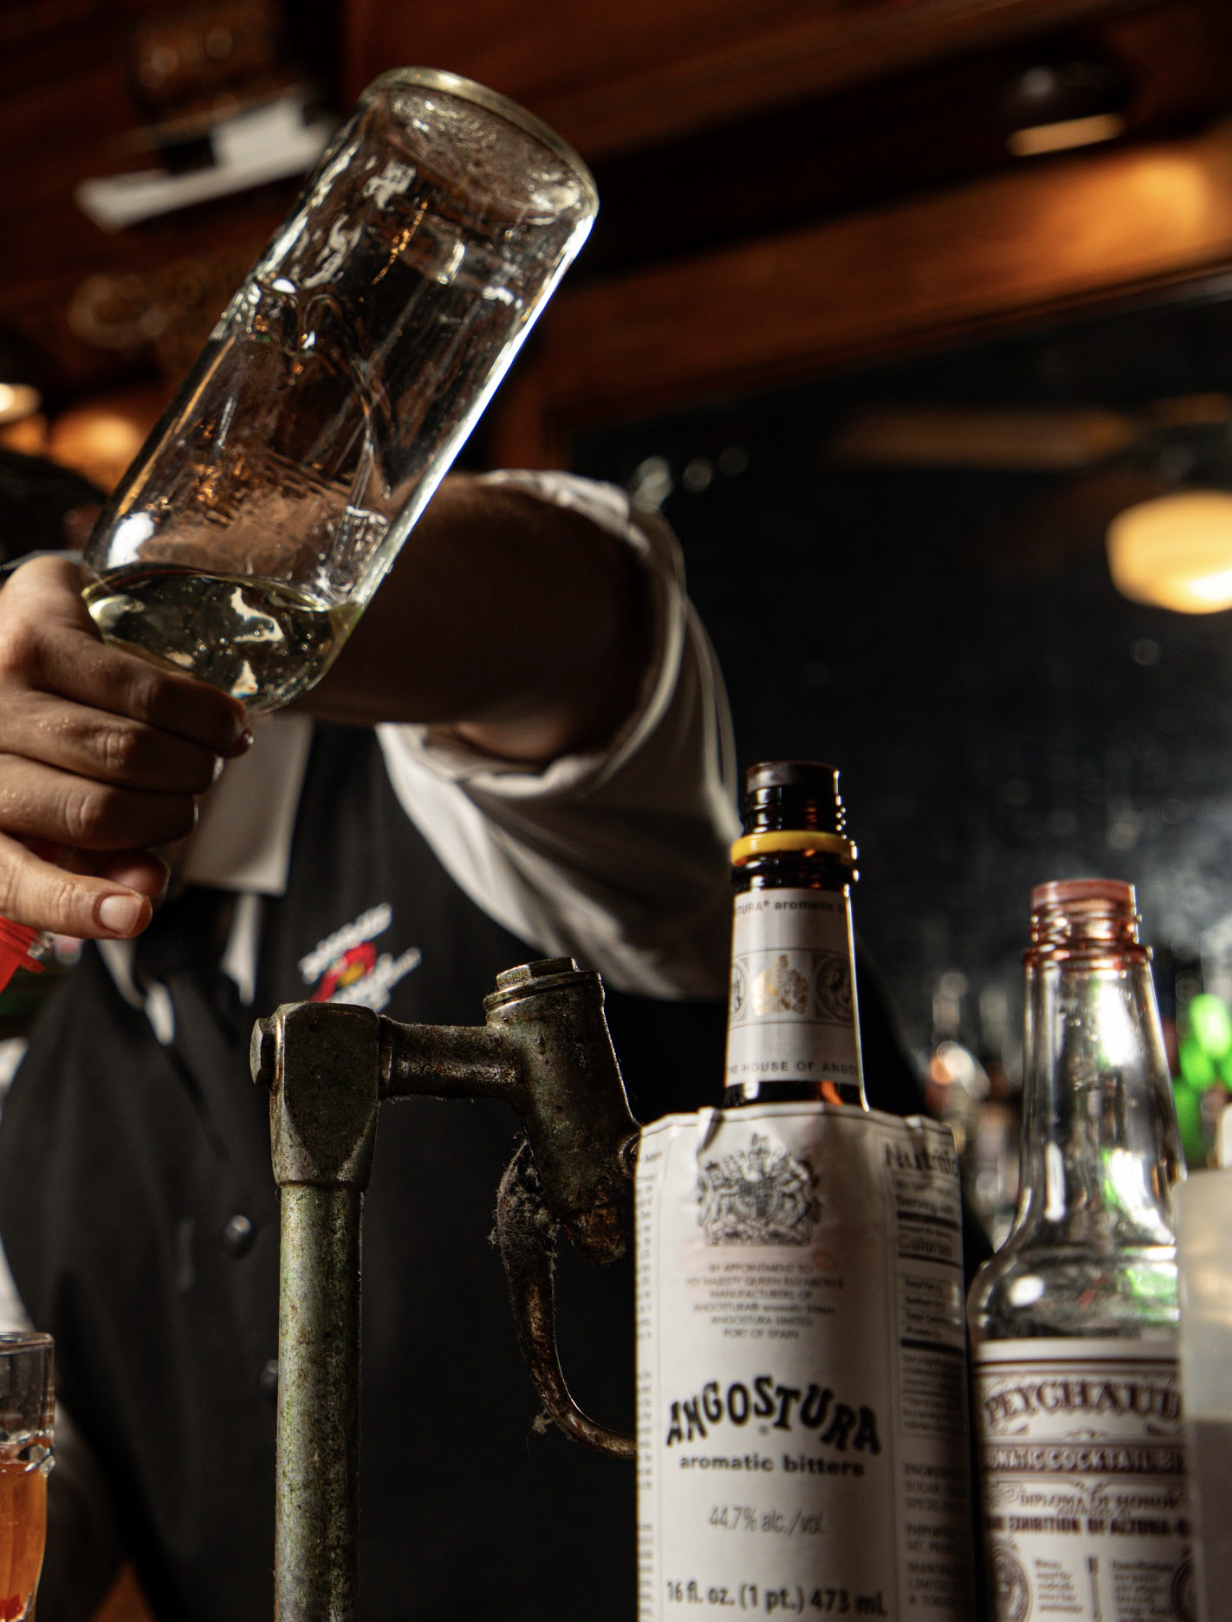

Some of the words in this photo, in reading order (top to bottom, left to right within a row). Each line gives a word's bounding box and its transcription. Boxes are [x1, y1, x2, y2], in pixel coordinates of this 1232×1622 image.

[743, 1061, 789, 1073] HOUSE
[797, 1061, 815, 1073] OF
[666, 1374, 882, 1455] ANGOSTURA
[679, 1453, 774, 1471] aromatic
[783, 1454, 866, 1477] bitters
[1046, 1450, 1150, 1471] COCKTAIL
[709, 1505, 756, 1532] 44.7%
[667, 1580, 682, 1603] 16
[686, 1580, 704, 1605] fl.
[708, 1586, 735, 1606] oz.
[740, 1584, 758, 1611] (1
[765, 1585, 805, 1615] pt.)
[810, 1586, 850, 1614] 473
